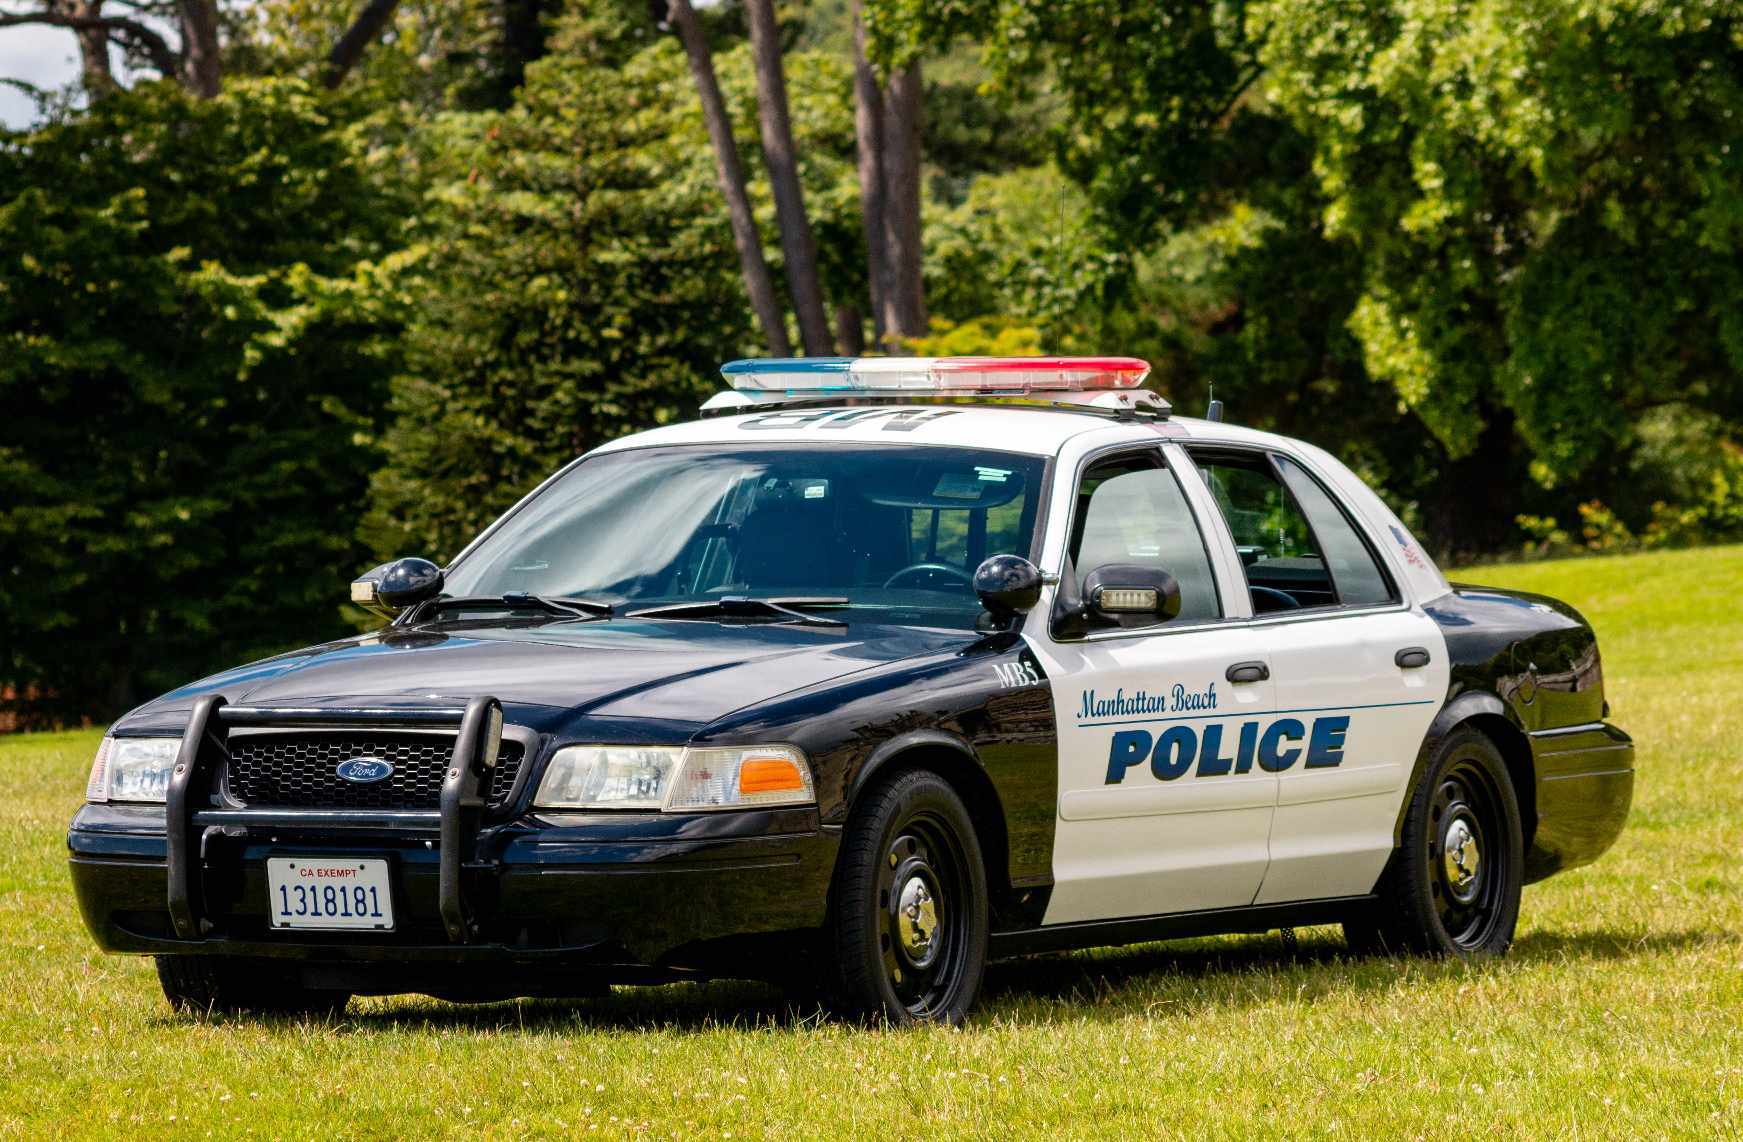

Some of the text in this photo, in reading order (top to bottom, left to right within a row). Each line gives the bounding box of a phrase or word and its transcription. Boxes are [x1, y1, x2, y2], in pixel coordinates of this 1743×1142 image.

[992, 661, 1040, 689] MB5
[1077, 681, 1218, 719] Manhattan Beach
[1104, 715, 1351, 785] POLICE
[348, 762, 378, 777] Ford
[300, 868, 358, 879] CA EXEMPT
[280, 884, 383, 918] 1318181
